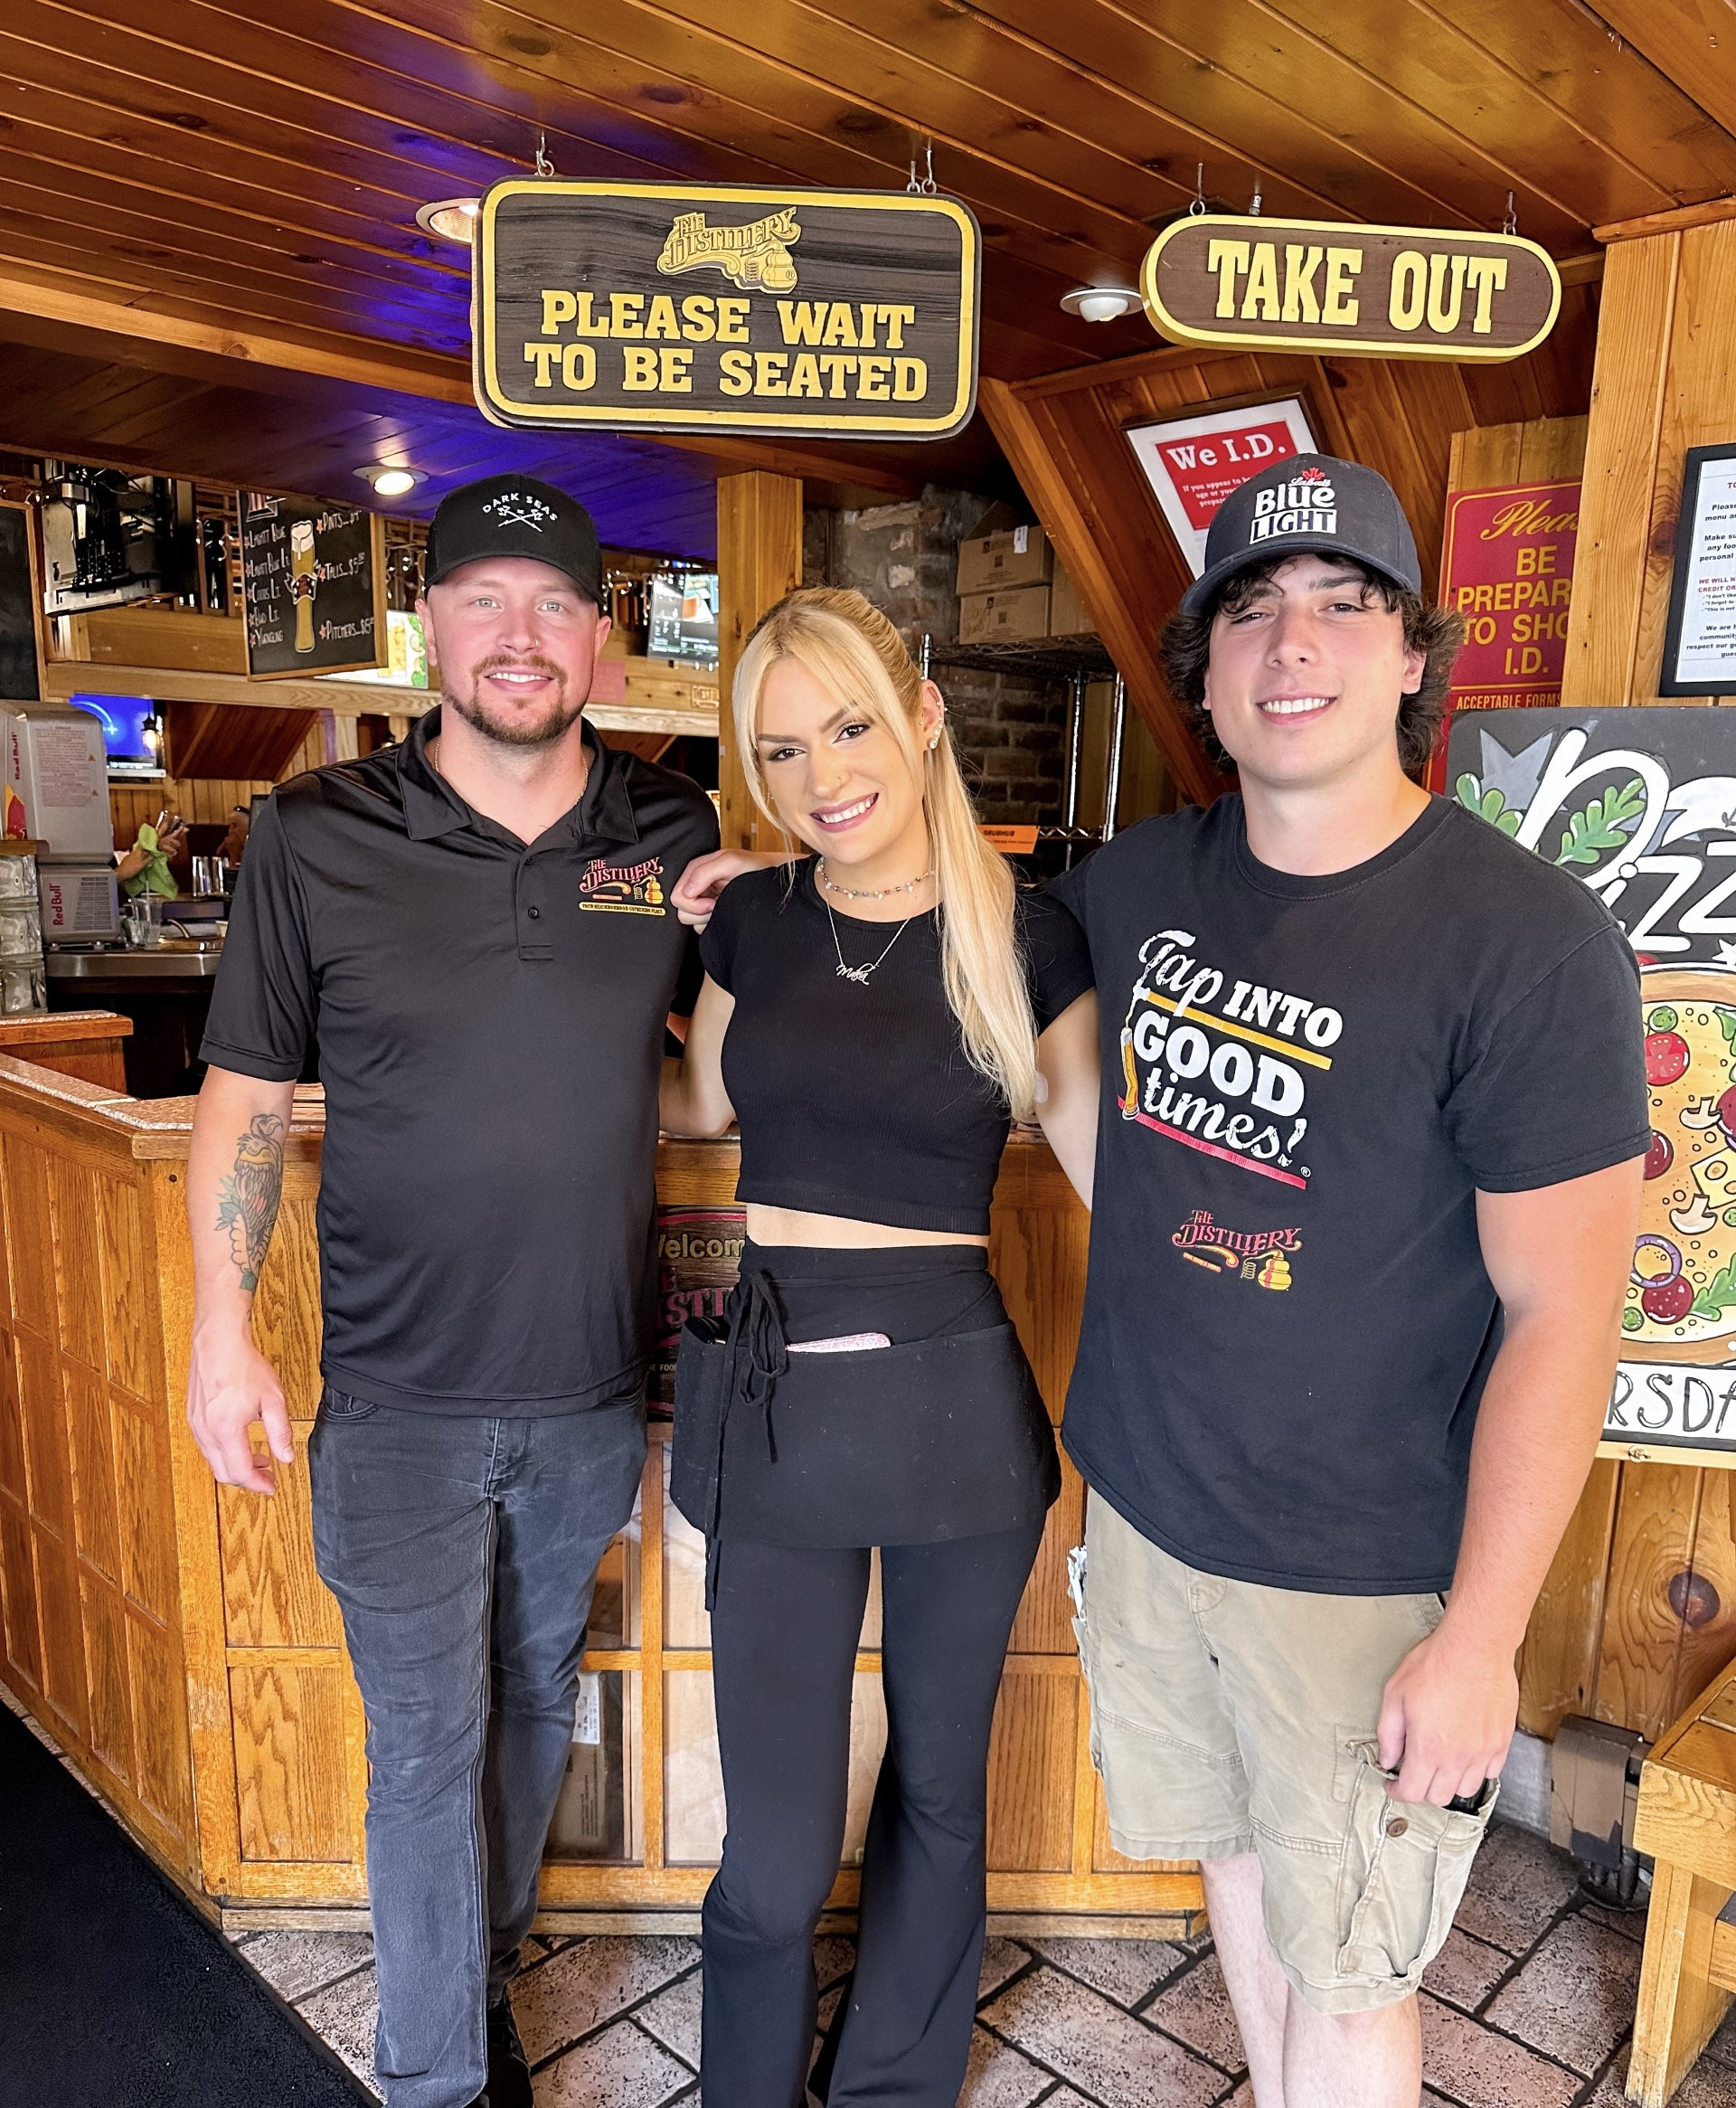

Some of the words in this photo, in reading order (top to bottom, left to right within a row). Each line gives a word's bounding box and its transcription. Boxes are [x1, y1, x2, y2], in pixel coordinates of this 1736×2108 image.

[661, 209, 800, 269] DISTILLERY
[674, 214, 704, 238] THE
[1207, 239, 1363, 326] TAKE
[1389, 250, 1508, 334] OUT
[541, 289, 751, 344] PLEASE
[776, 299, 915, 350] WAIT
[524, 343, 596, 391] TO
[622, 346, 693, 392] BE
[719, 351, 928, 402] SEATED
[1166, 445, 1218, 470] We
[1222, 433, 1286, 462] I.D.
[1182, 485, 1190, 493] If
[1191, 484, 1205, 493] you
[1205, 480, 1231, 491] appear
[1196, 492, 1209, 500] age
[1288, 477, 1331, 487] Labatt
[482, 493, 520, 513] DARK
[525, 496, 558, 521] SEAS
[1255, 484, 1335, 518] Blue
[1251, 510, 1335, 543] LIGHT
[1704, 514, 1727, 522] menu
[1704, 534, 1726, 542] Make
[1706, 544, 1722, 552] any
[1515, 545, 1558, 576] BE
[1699, 553, 1734, 563] personal
[1698, 585, 1724, 593] CREDIT
[1462, 617, 1497, 646] TO
[1504, 647, 1549, 676] I.D.
[1457, 694, 1523, 710] ACCEPTABLE
[1525, 693, 1561, 708] FORMS
[580, 857, 664, 893] DISTILLERY
[588, 859, 607, 873] THE
[50, 885, 62, 905] Bull
[51, 905, 64, 926] Red
[1137, 930, 1224, 1016] Tap
[1222, 979, 1343, 1048] INTO
[1134, 1010, 1305, 1117] GOOD
[1144, 1067, 1307, 1167] times!
[1191, 1209, 1214, 1224] THE
[1172, 1224, 1302, 1256] DISTILLERY
